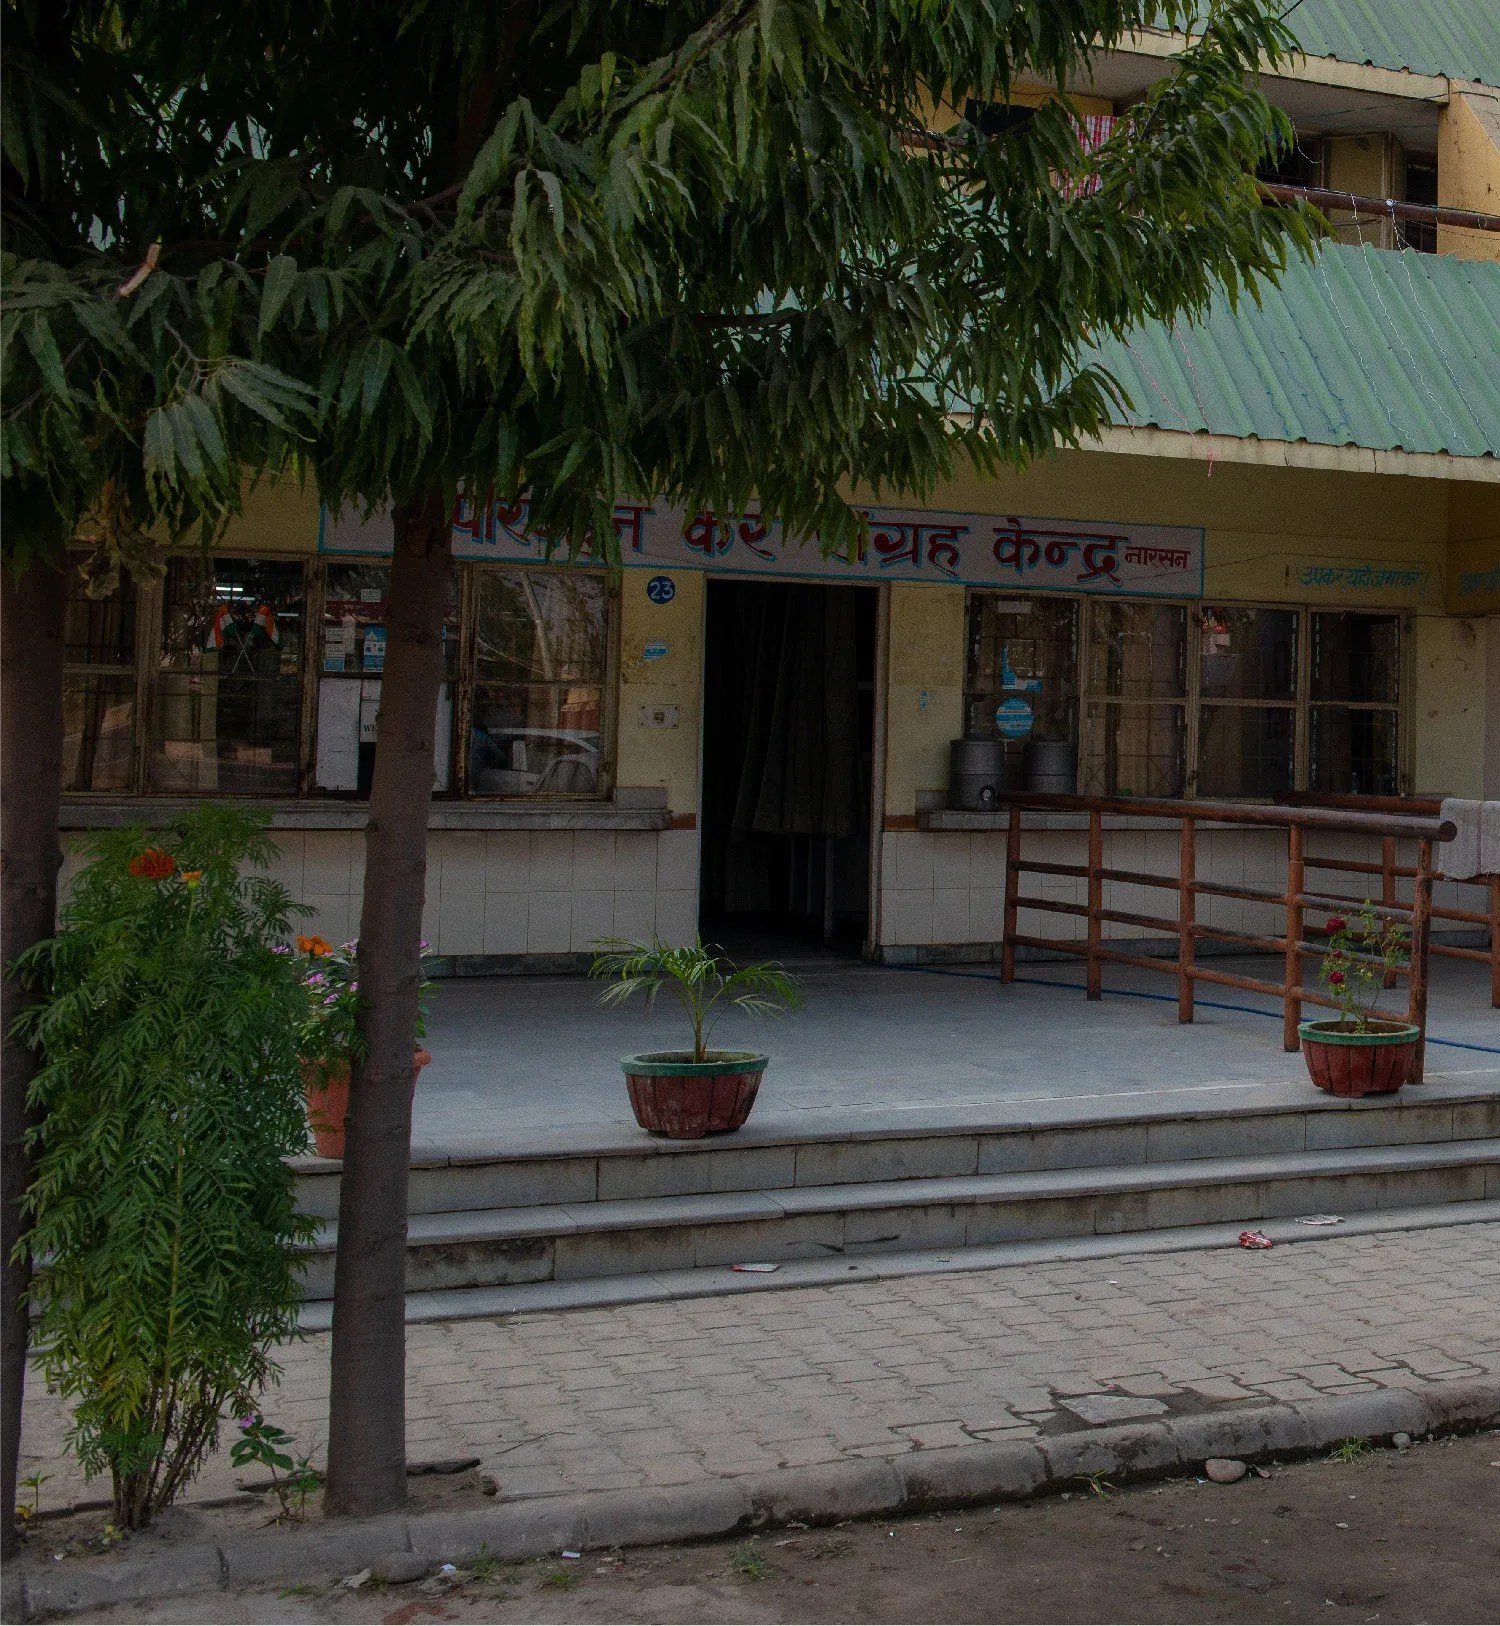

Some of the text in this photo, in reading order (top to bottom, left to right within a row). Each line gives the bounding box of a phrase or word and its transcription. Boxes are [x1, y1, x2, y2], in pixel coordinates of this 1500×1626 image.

[993, 517, 1129, 584] केन्द्र
[1124, 545, 1192, 570] नारसन
[649, 580, 675, 599] 23
